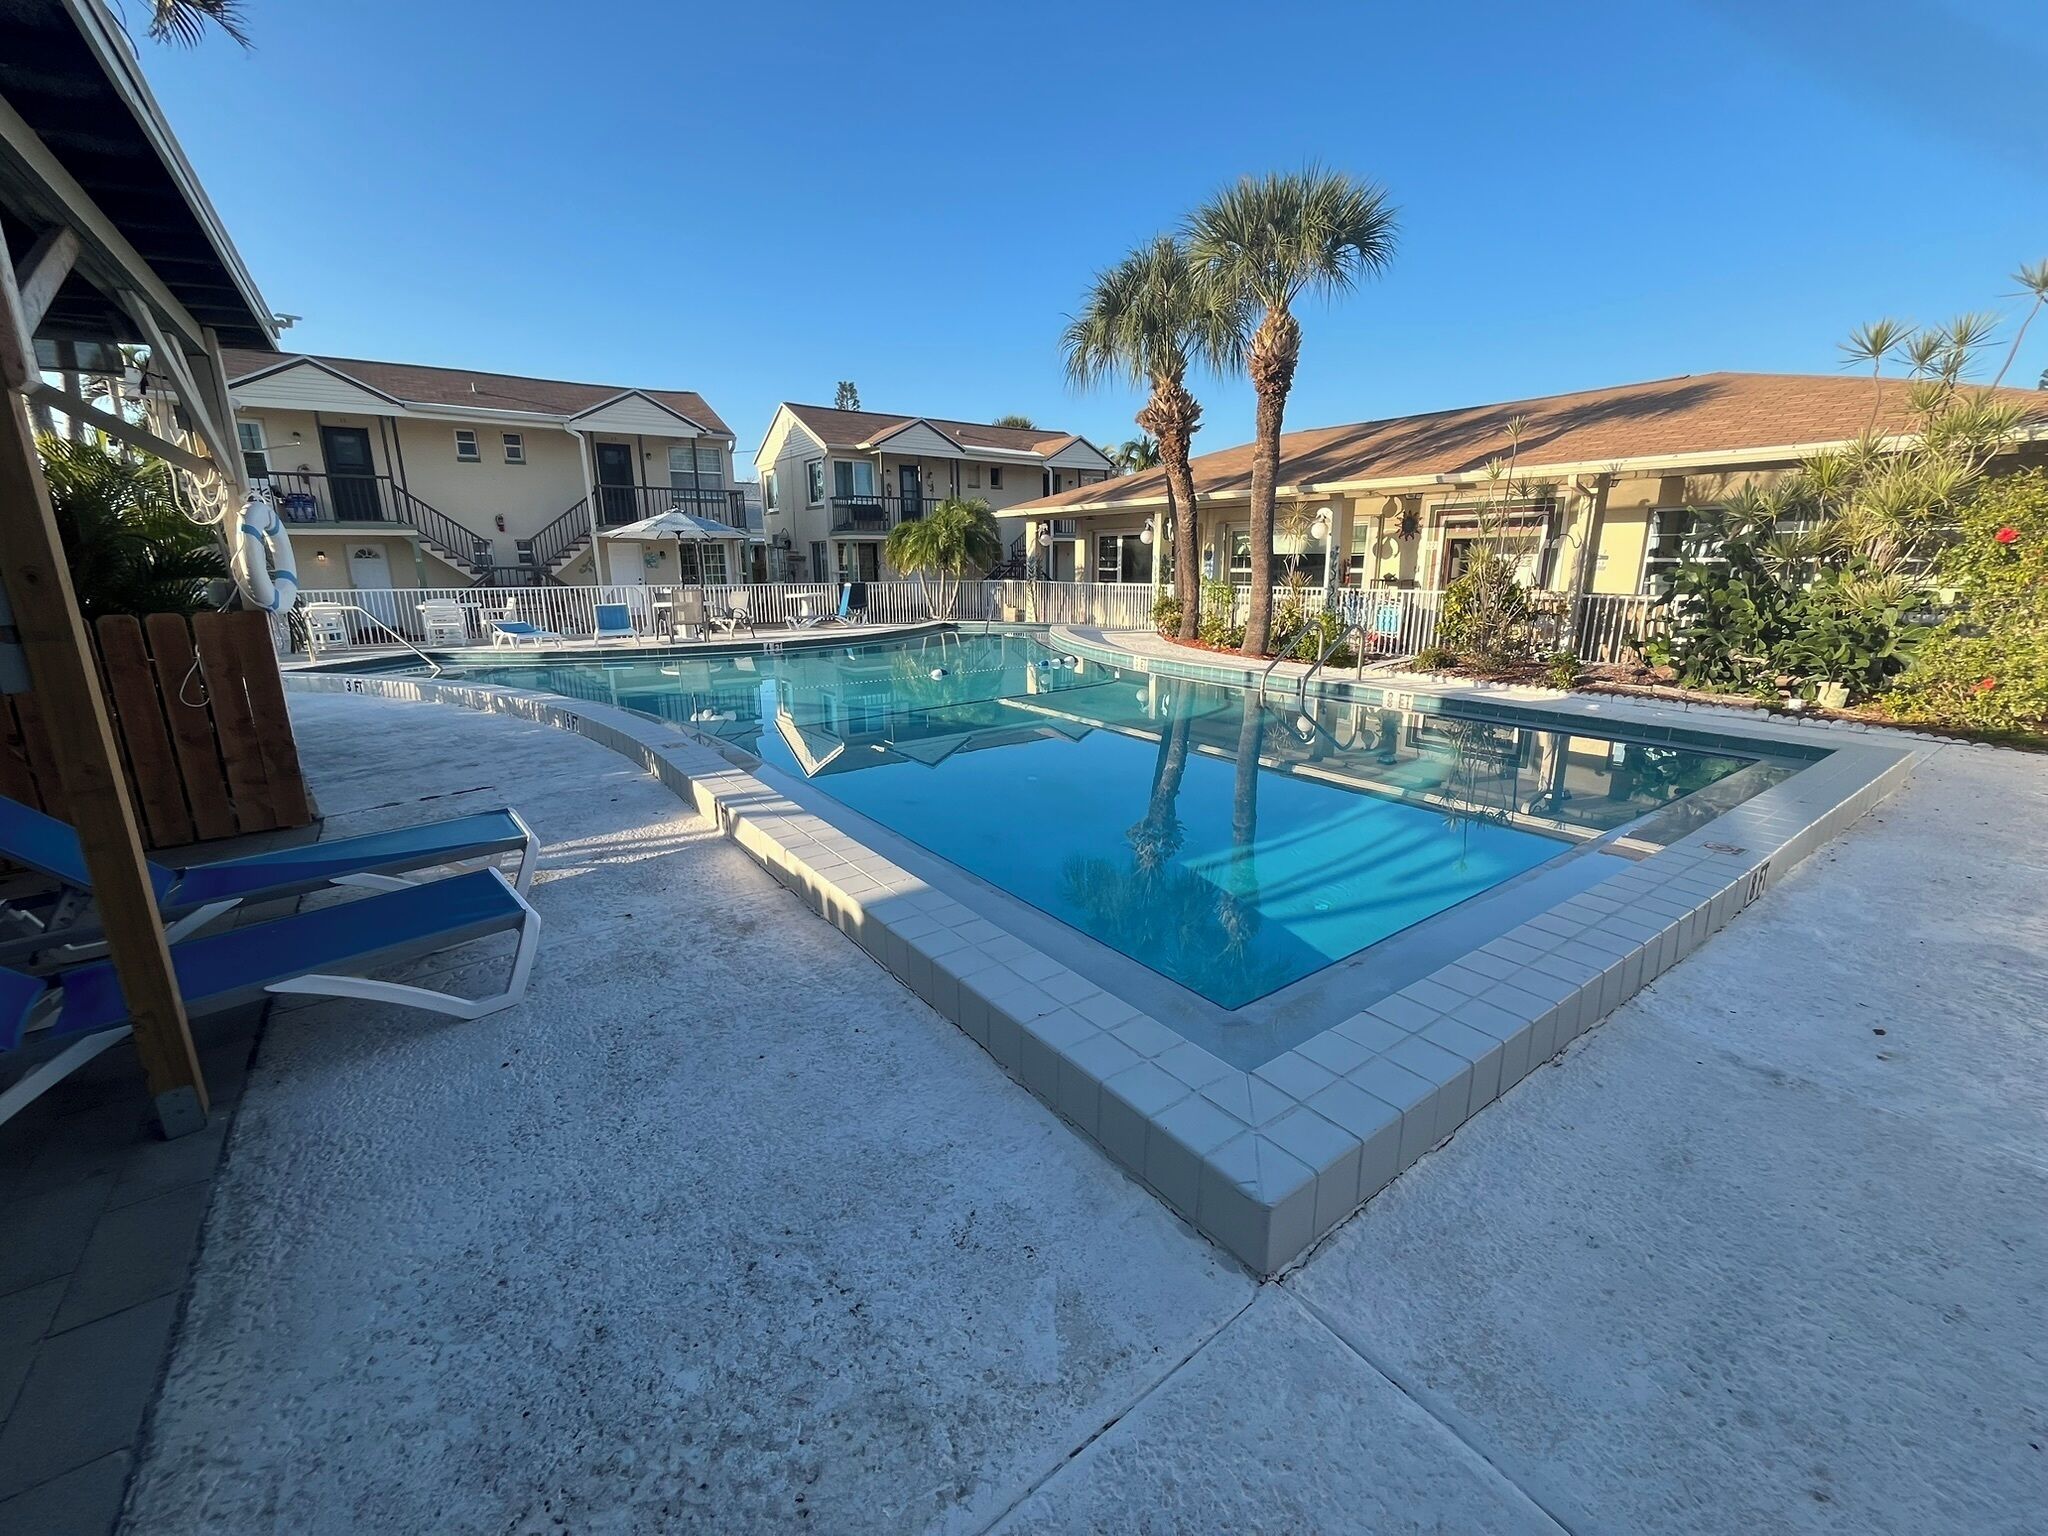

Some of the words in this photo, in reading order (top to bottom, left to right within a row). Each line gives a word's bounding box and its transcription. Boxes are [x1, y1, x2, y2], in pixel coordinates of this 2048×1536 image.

[346, 681, 352, 692] 3
[354, 681, 363, 693] FT
[1756, 860, 1771, 895] FT
